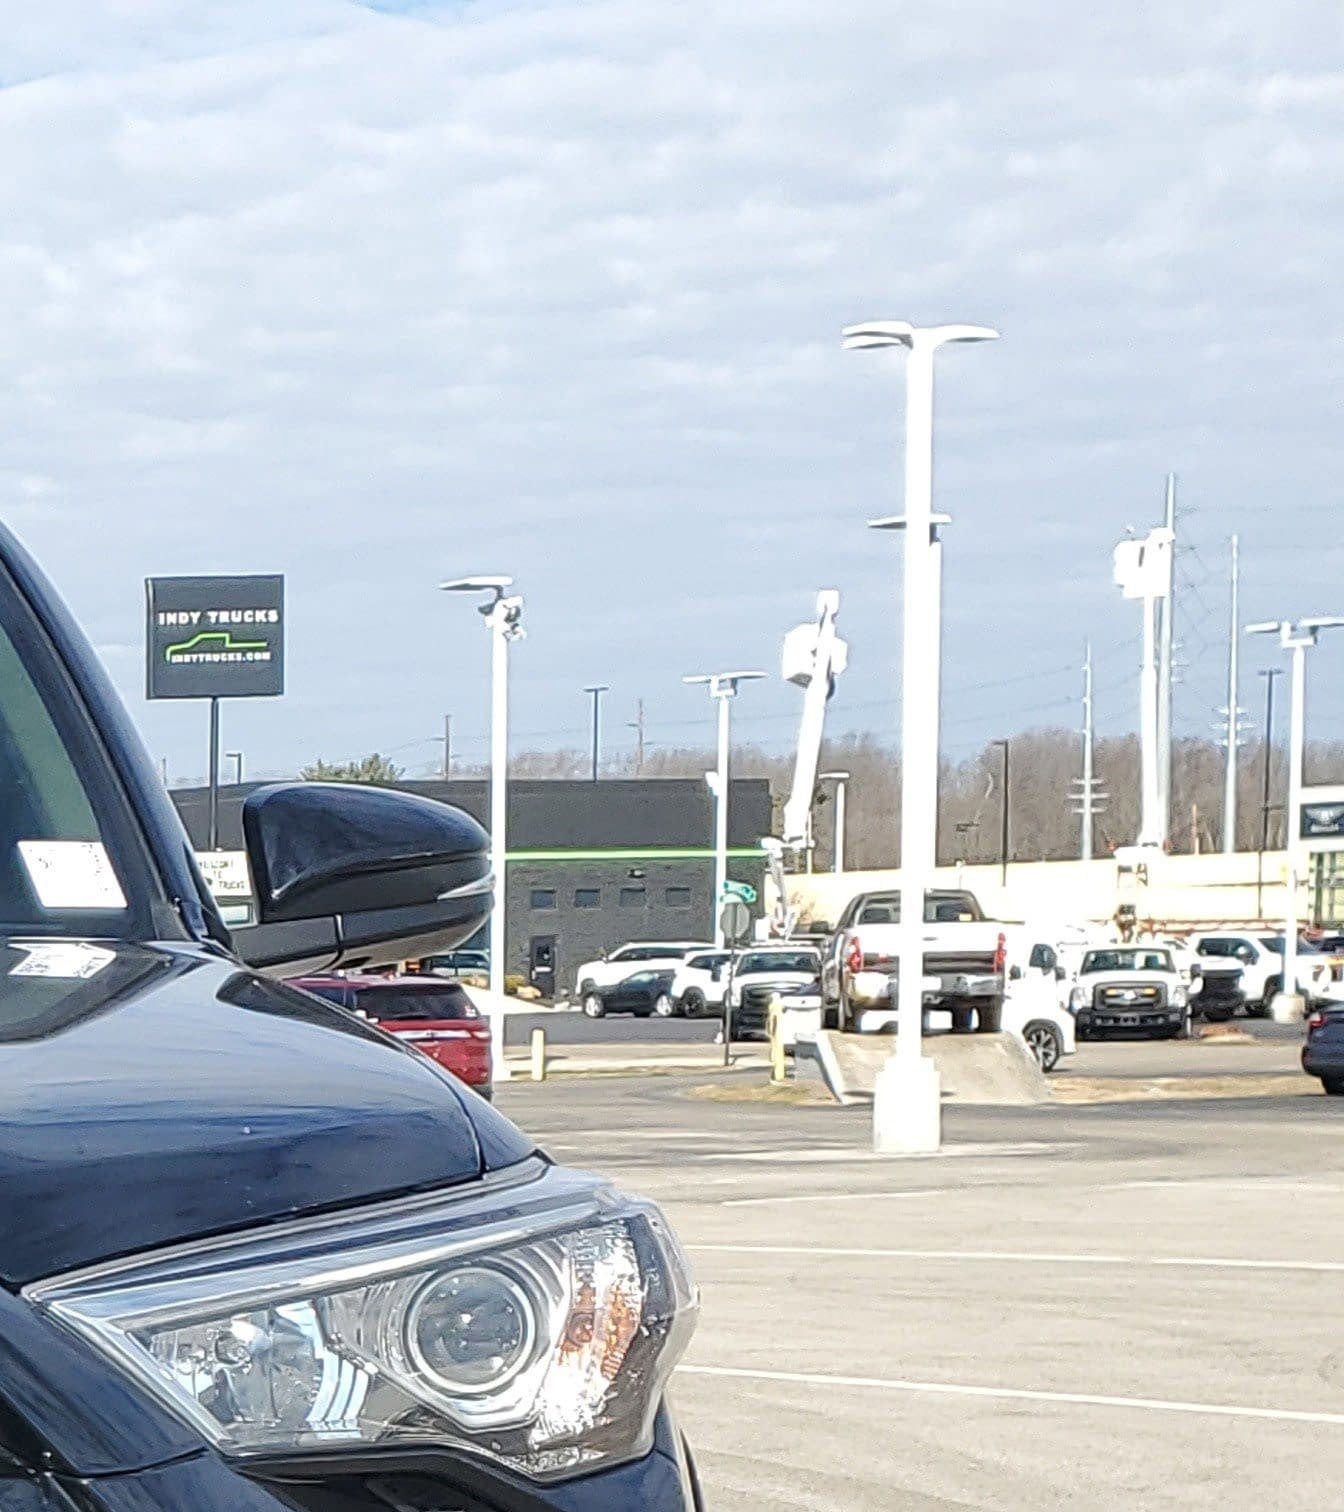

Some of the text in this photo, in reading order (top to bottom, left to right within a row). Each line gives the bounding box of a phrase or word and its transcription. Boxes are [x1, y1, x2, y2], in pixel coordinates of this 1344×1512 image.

[158, 609, 279, 625] INDY TRUCKS
[171, 651, 271, 664] INDYTRUCKS.COM
